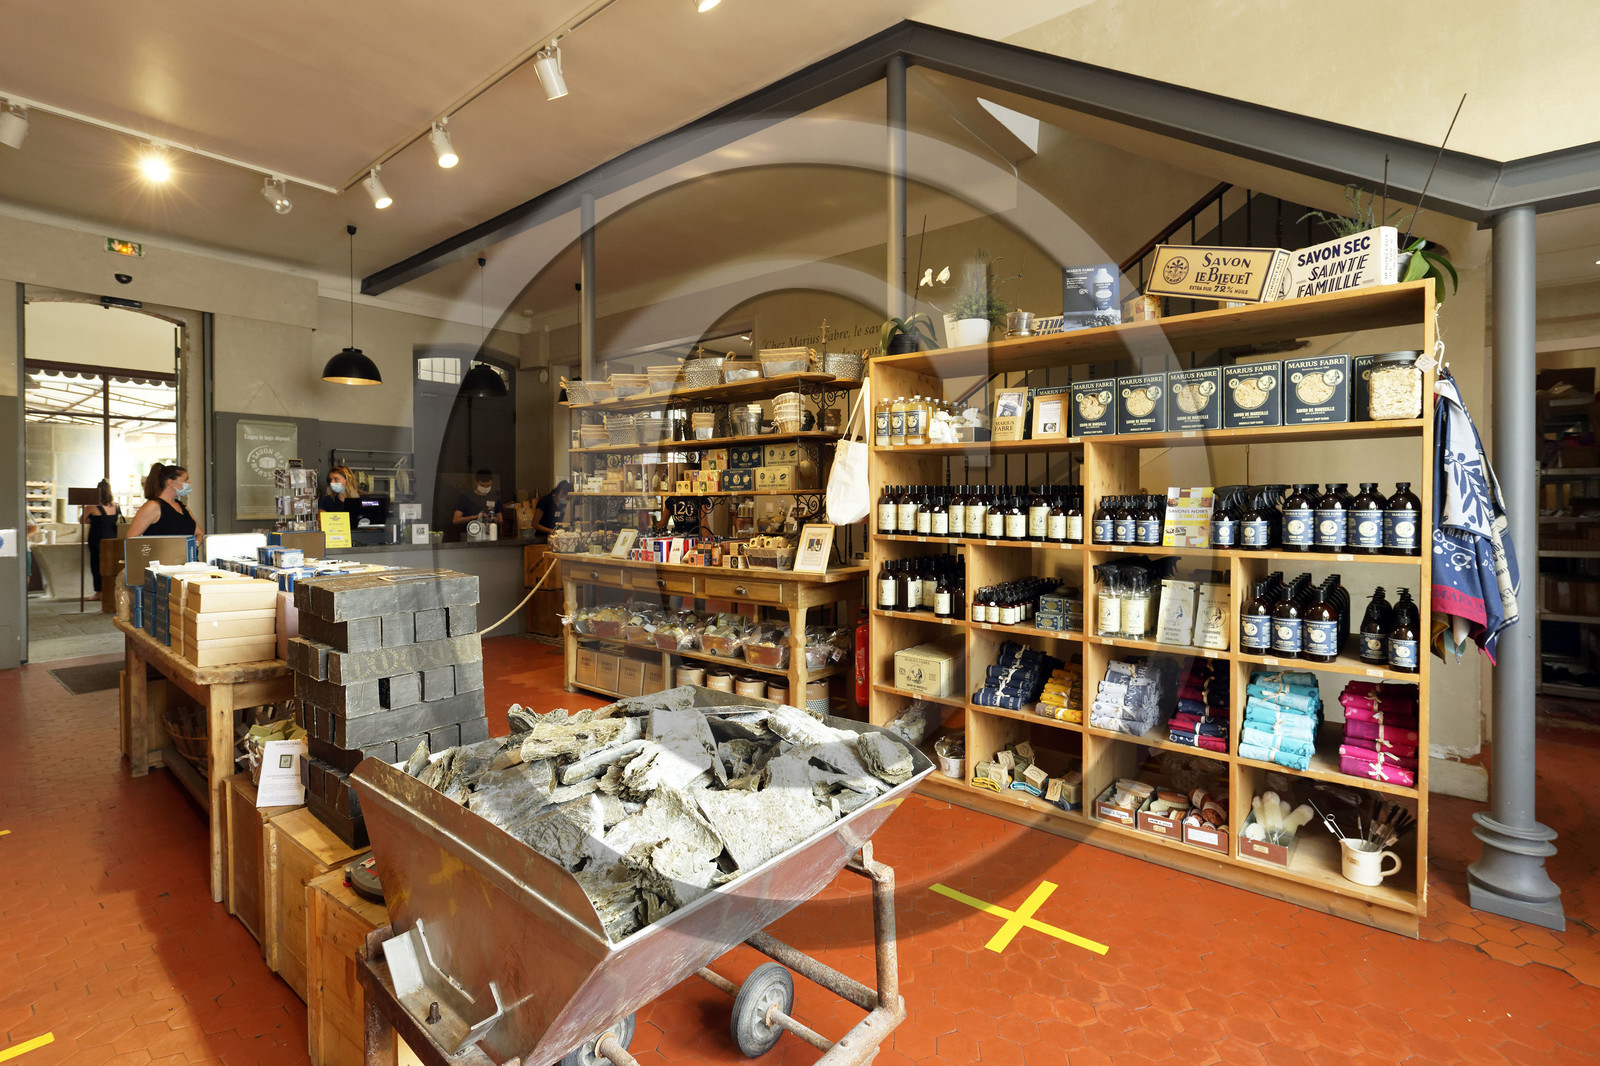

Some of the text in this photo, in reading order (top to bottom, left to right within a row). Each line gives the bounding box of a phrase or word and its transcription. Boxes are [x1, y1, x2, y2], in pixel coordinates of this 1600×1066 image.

[1297, 235, 1371, 268] SAVON SEC
[1201, 252, 1252, 268] SAVON
[1307, 253, 1370, 282] SAINTE
[1194, 271, 1210, 285] LE
[1207, 266, 1254, 286] BLEUET
[1296, 270, 1364, 298] FAMILLE
[788, 334, 820, 348] Marius
[853, 324, 862, 337] le
[1225, 363, 1278, 376] MARIUS FABRE
[1287, 357, 1345, 370] MARIUS FABRE
[1119, 375, 1163, 386] MARIUS FABRE
[1170, 369, 1217, 381] MARIUS FABRE
[1095, 380, 1114, 389] FABRE
[252, 448, 284, 460] SAVON DE
[672, 501, 695, 517] 120
